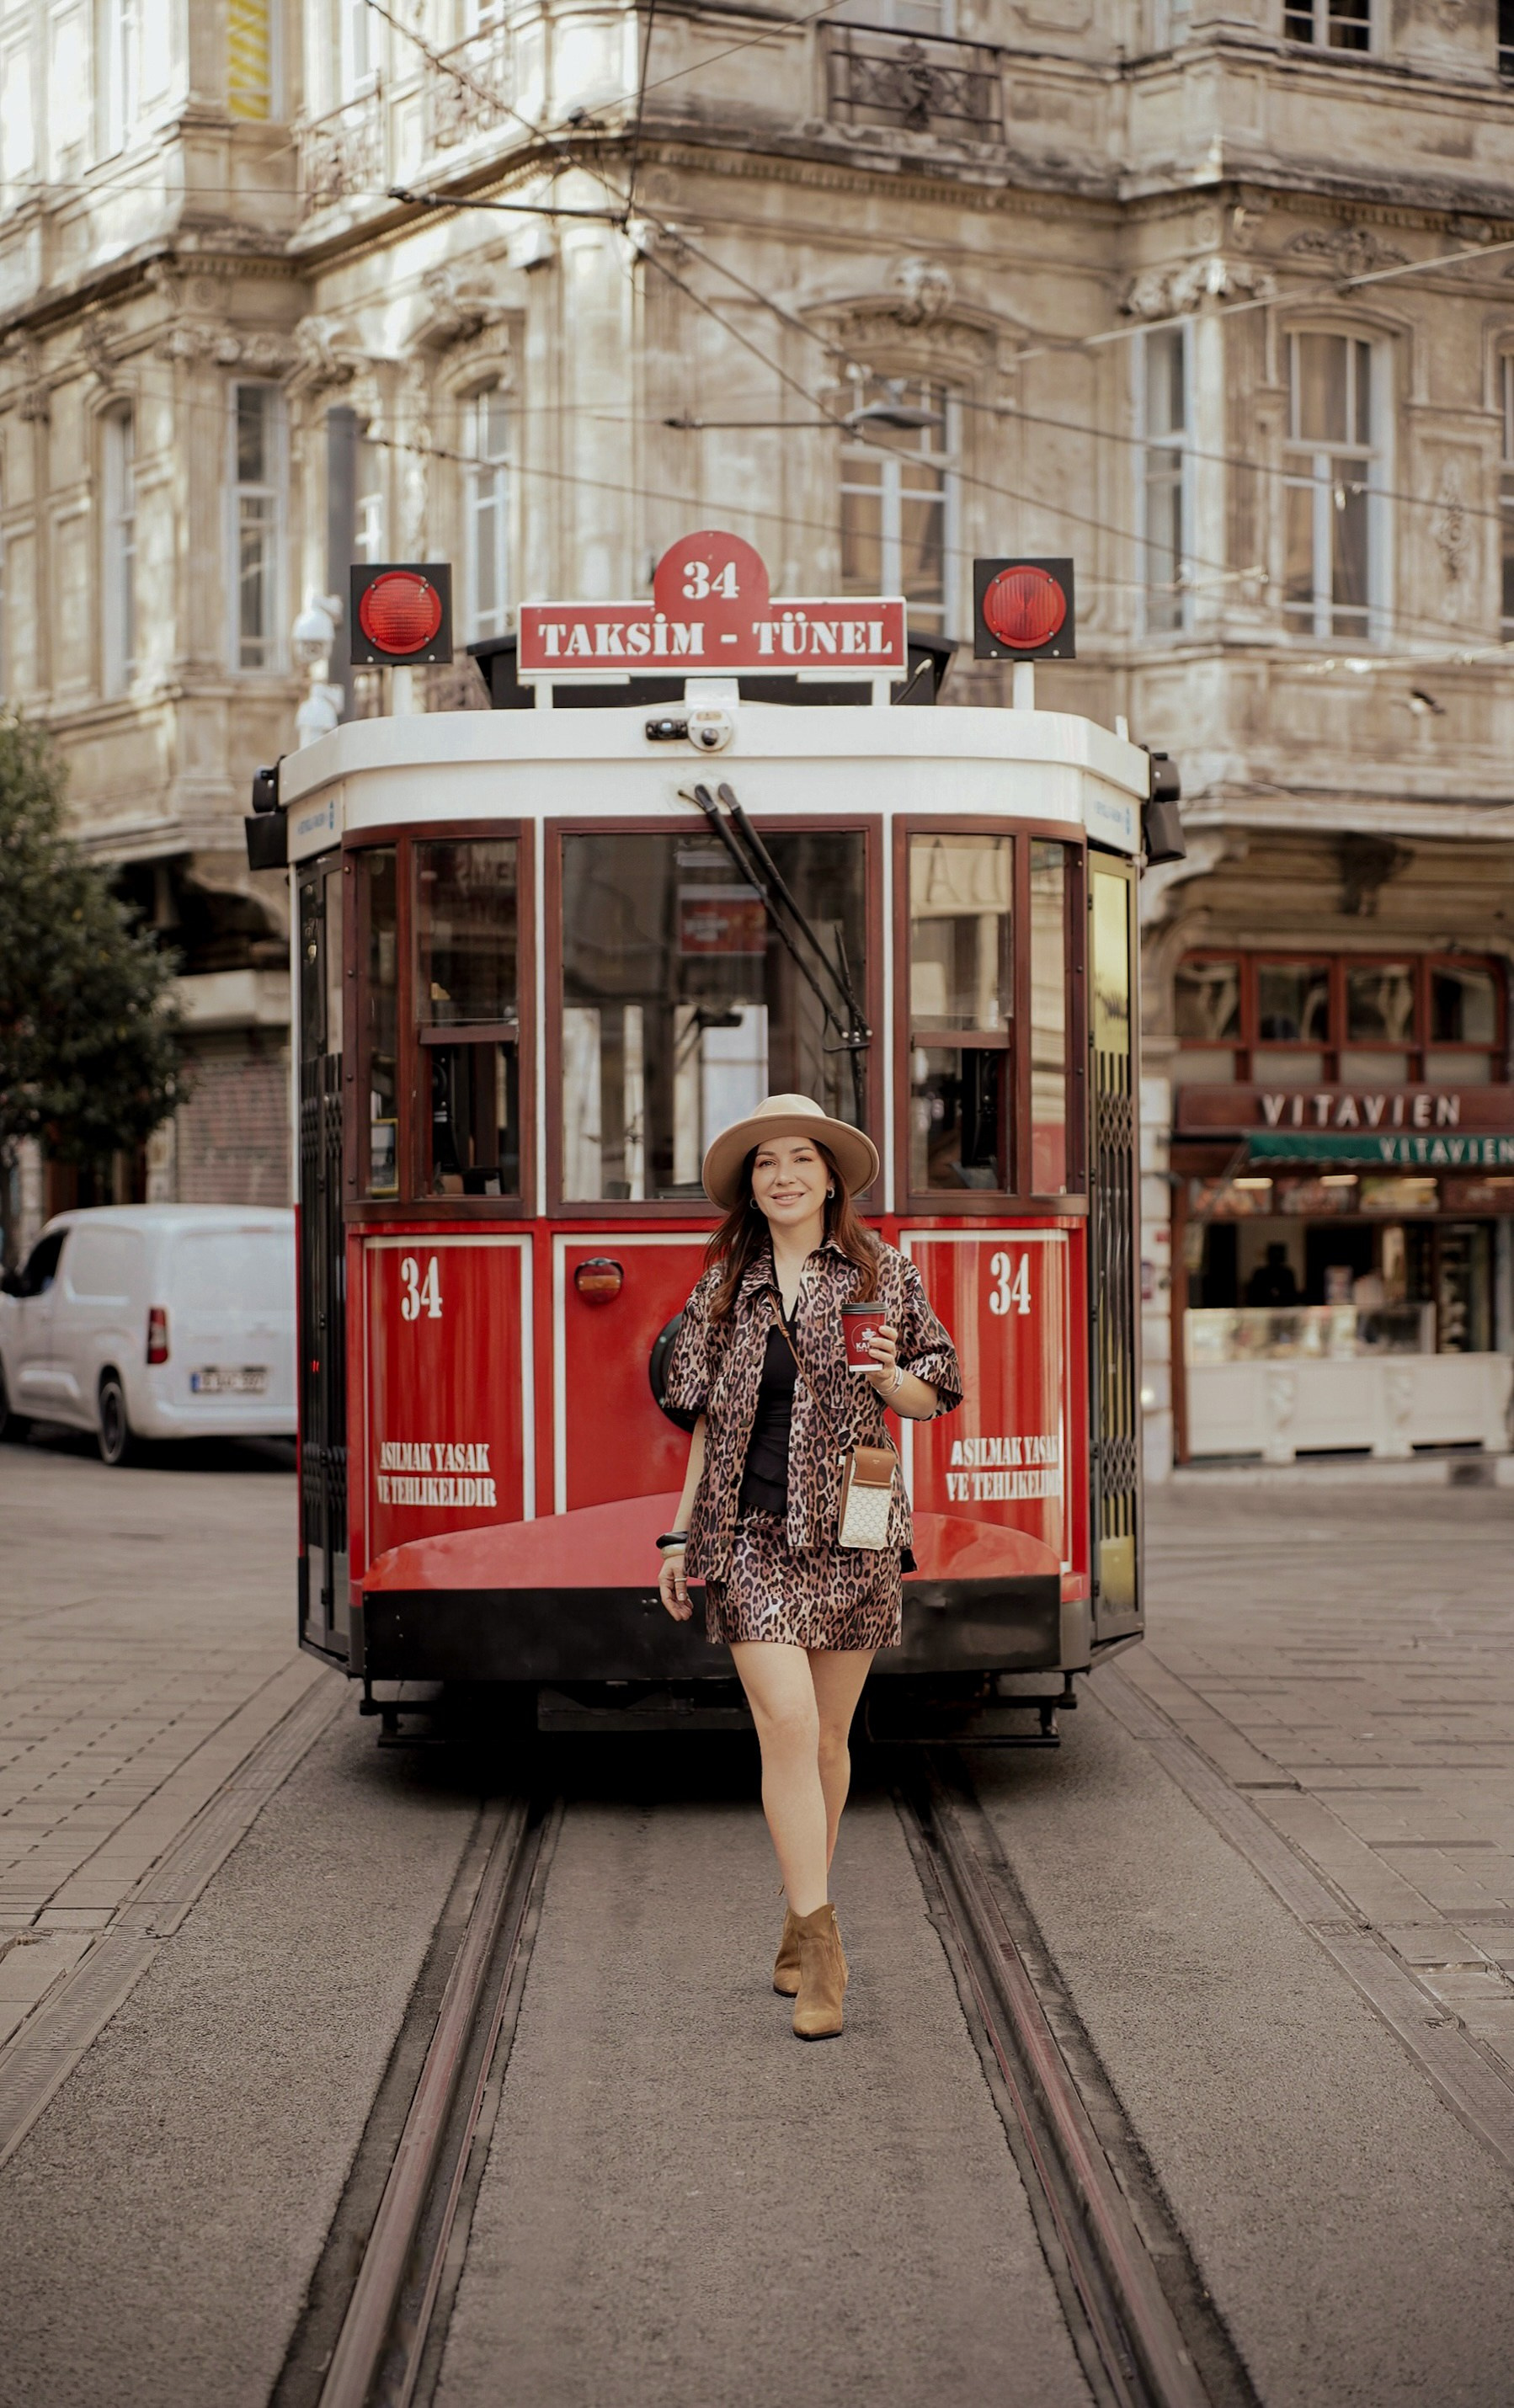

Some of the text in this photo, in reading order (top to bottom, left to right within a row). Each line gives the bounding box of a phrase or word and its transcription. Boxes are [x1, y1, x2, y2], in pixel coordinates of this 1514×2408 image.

[682, 562, 739, 599] 34
[538, 612, 705, 657] TAKSİM
[752, 611, 893, 654] TÜNEL
[1263, 1094, 1461, 1128] VITAVIEN
[401, 1256, 444, 1321] 34
[989, 1252, 1032, 1315] 34
[380, 1441, 491, 1473] ASILMAK YASAK
[951, 1436, 1023, 1467] ASILMAK
[945, 1472, 970, 1502] VE
